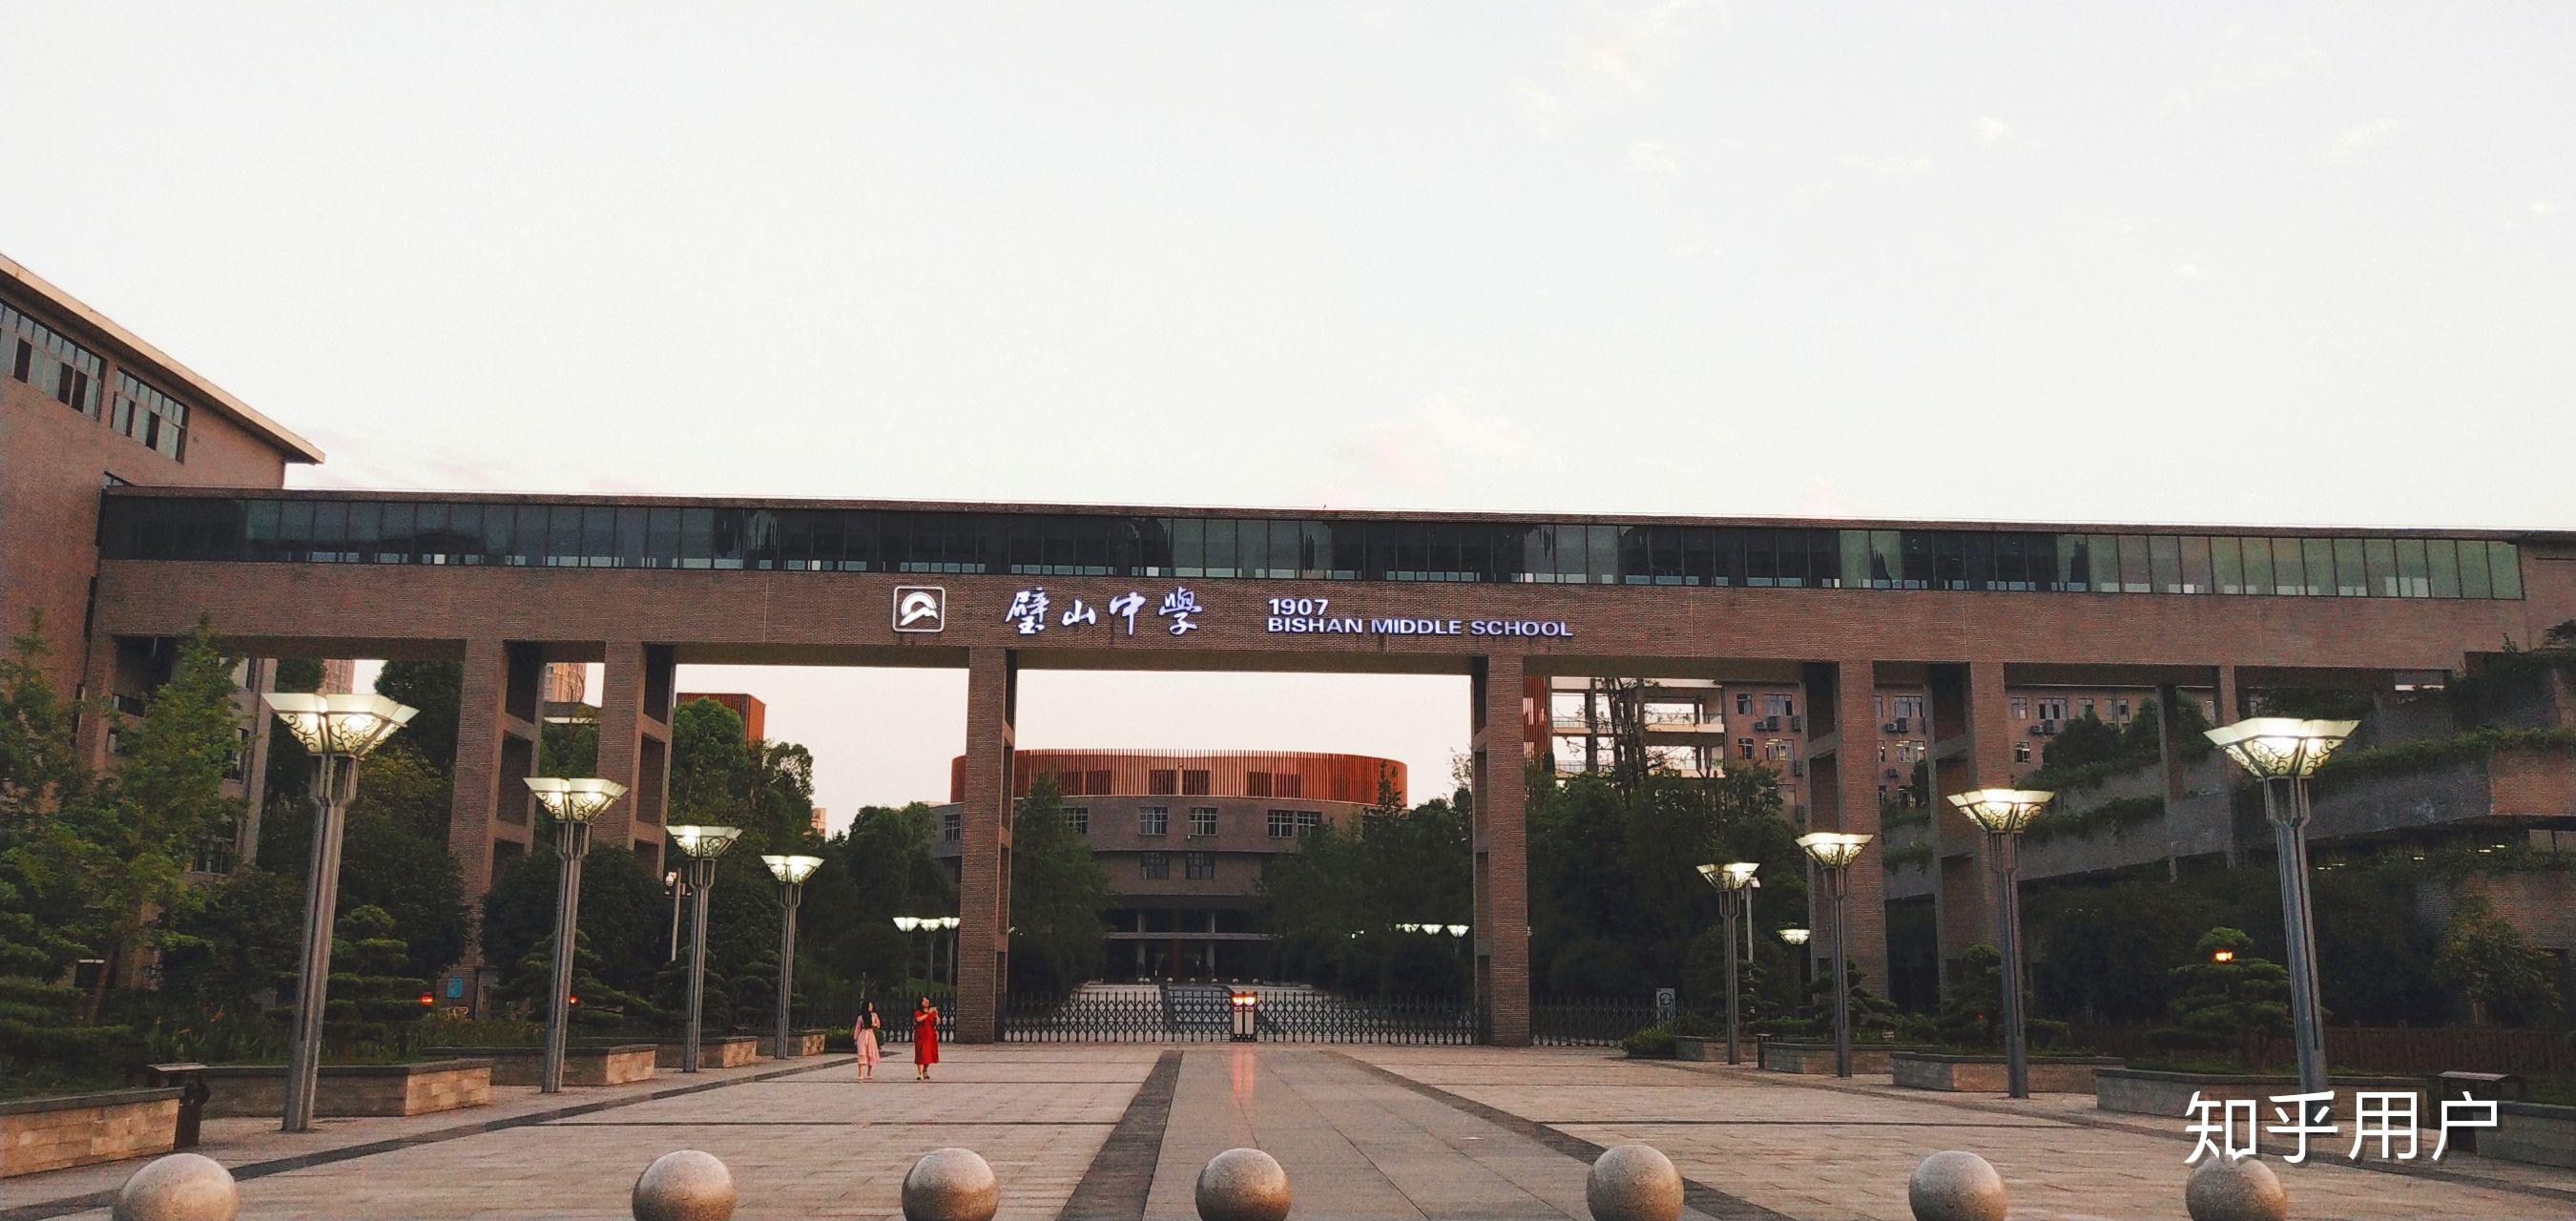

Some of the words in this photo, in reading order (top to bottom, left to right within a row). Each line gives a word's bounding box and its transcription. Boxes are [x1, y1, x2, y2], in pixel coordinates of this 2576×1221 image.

[1268, 597, 1329, 616] 1907
[1268, 616, 1362, 633] BISHAN
[1371, 618, 1463, 635] MIDDLE
[1470, 620, 1574, 637] SCHOOL
